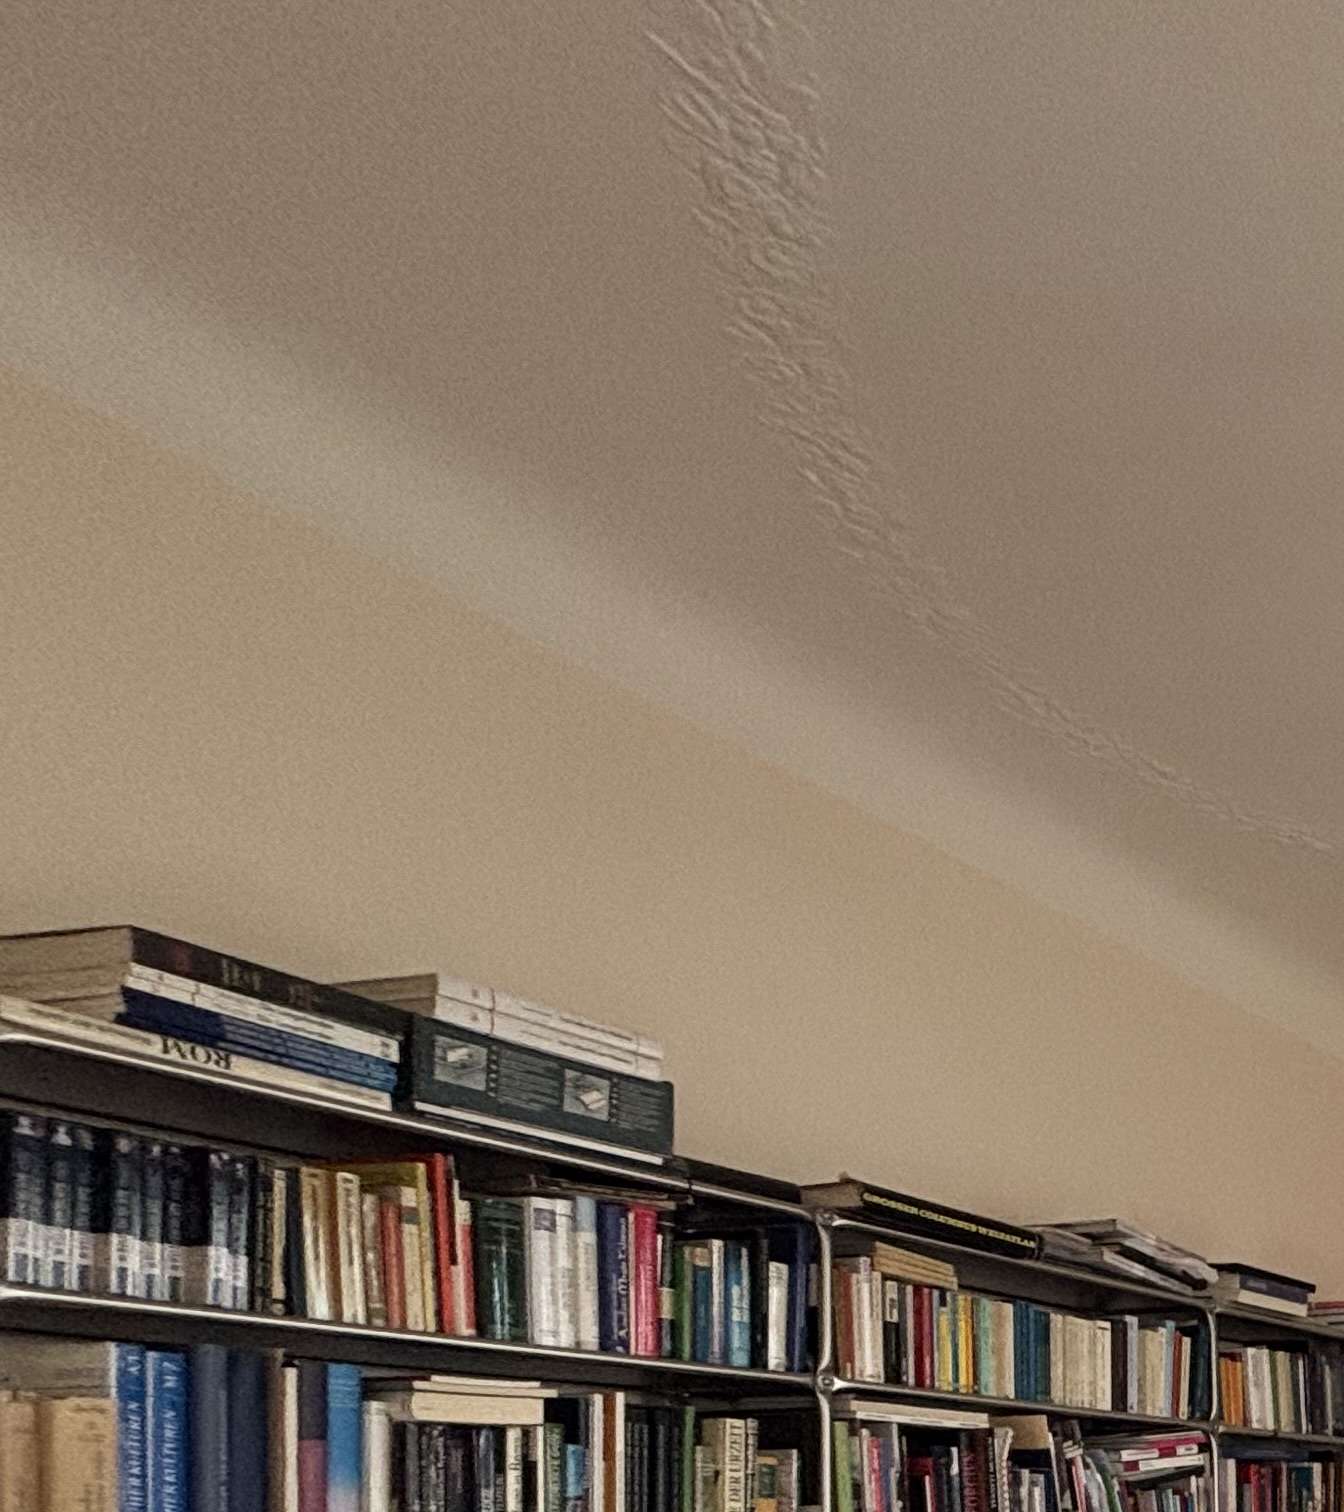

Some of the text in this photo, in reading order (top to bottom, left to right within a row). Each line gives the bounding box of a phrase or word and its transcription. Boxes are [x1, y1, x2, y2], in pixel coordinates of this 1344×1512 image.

[160, 1034, 233, 1070] ROM
[728, 1421, 742, 1473] URZEIT
[728, 1475, 742, 1503] DER
